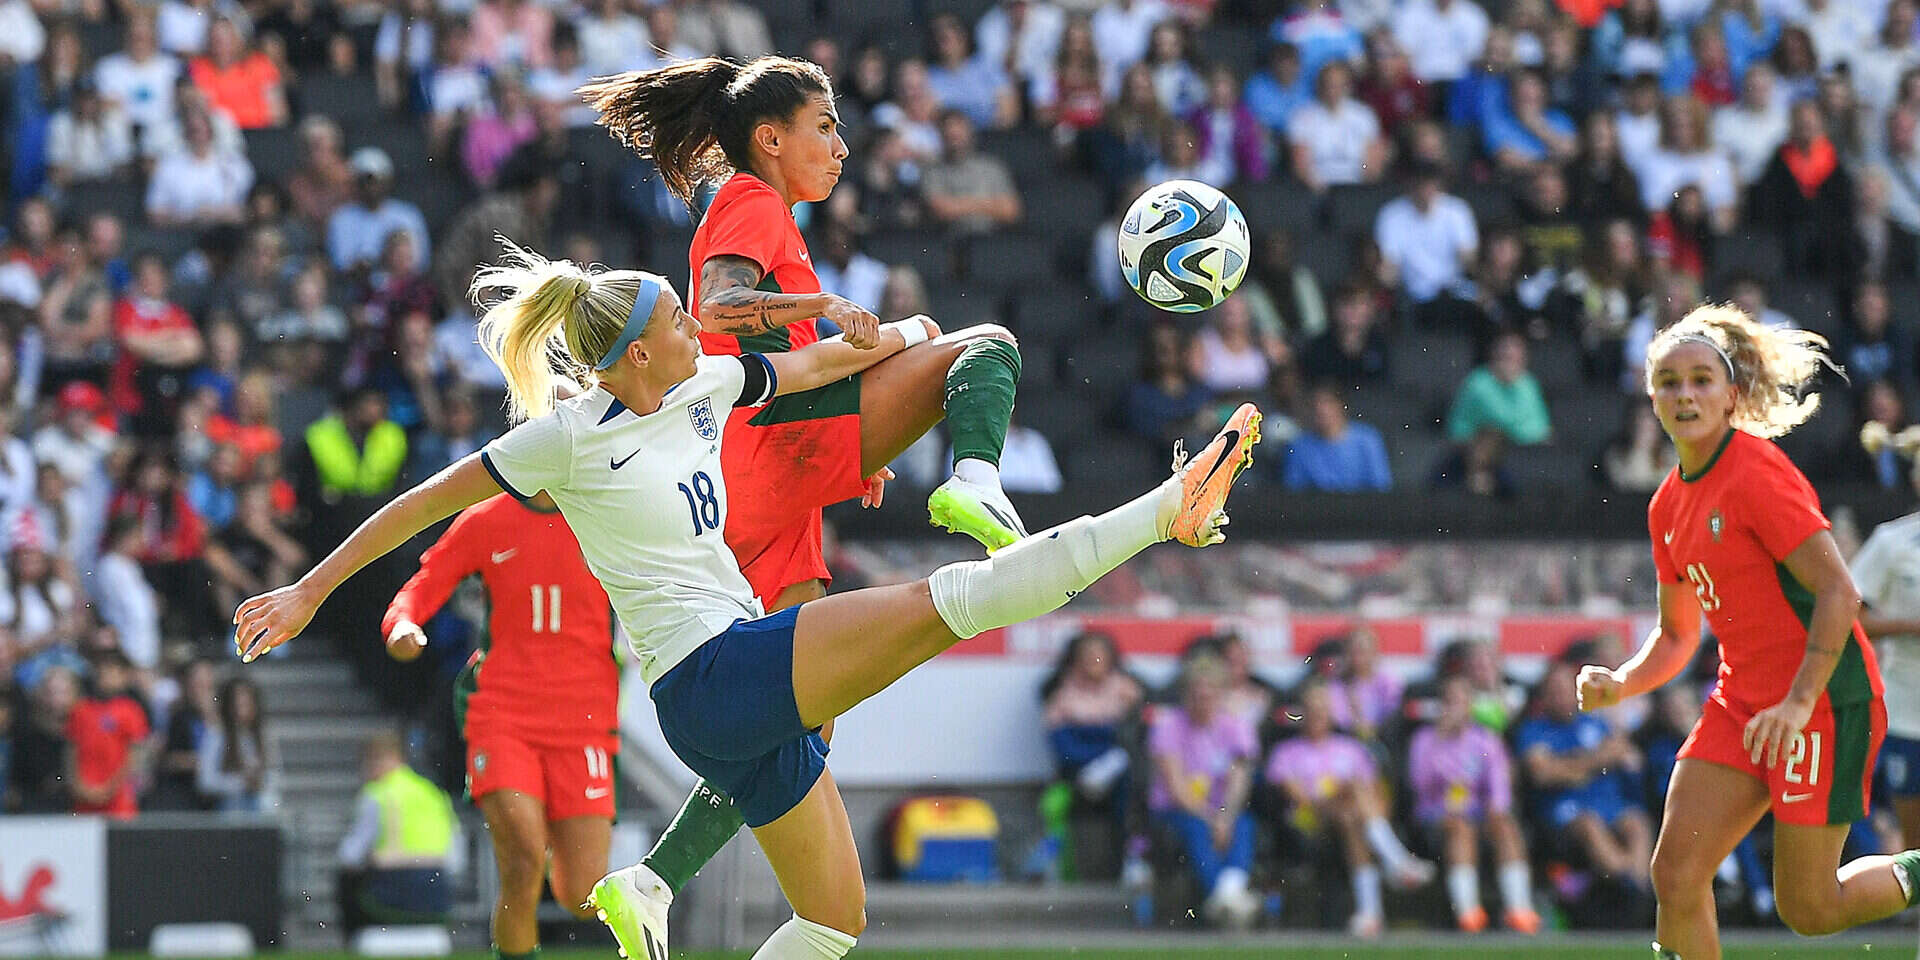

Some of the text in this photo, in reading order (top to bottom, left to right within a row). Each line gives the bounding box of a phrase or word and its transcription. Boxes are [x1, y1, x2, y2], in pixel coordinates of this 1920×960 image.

[678, 471, 719, 536] 18
[531, 584, 561, 633] 11
[1687, 562, 1720, 611] 21
[584, 746, 608, 779] 11
[1785, 732, 1821, 786] 21
